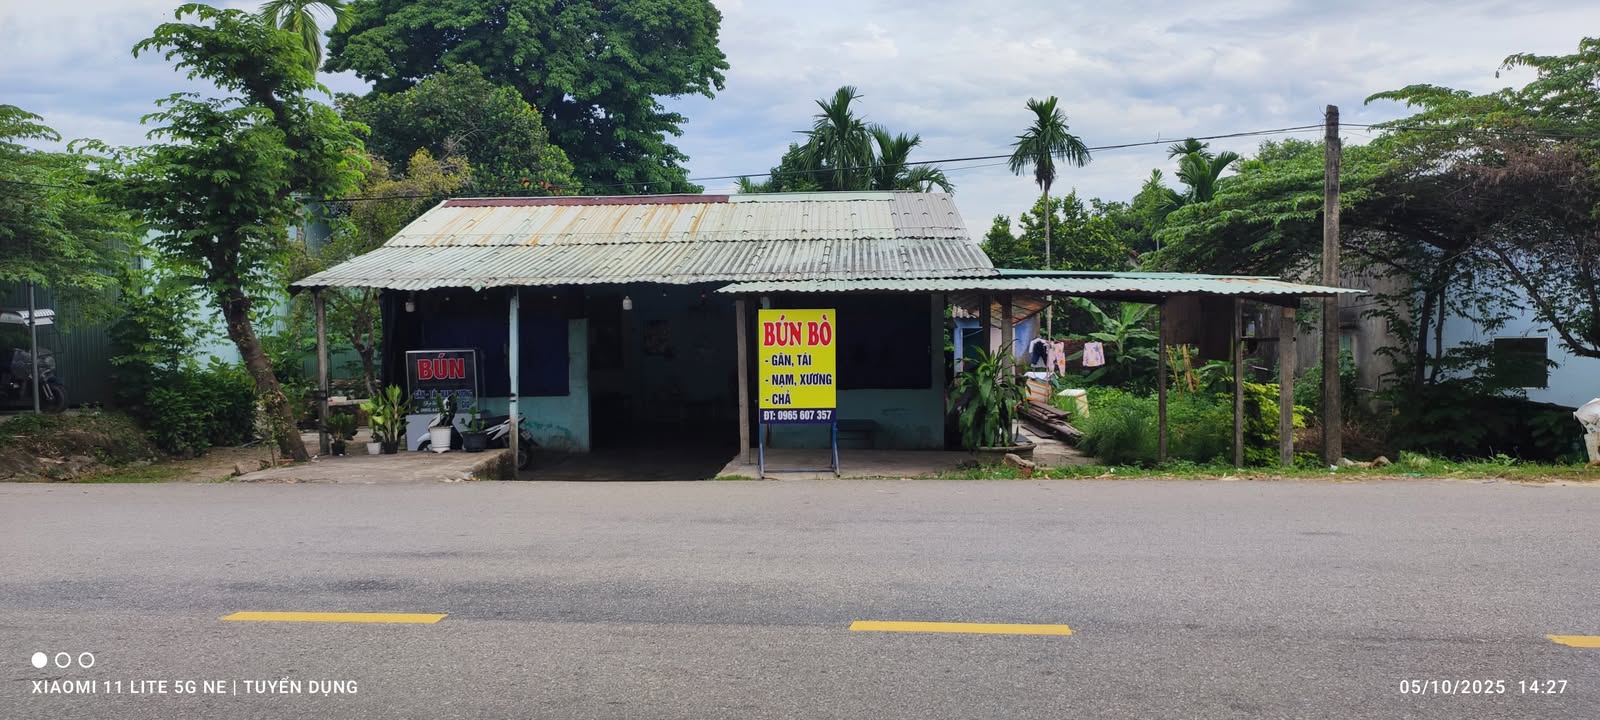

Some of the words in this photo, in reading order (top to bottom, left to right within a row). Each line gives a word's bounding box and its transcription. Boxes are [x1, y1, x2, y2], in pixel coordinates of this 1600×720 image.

[763, 314, 803, 346] BÚN
[807, 314, 832, 346] BÒ
[417, 353, 465, 380] BÚN
[797, 352, 812, 366] TÁI
[772, 374, 797, 388] NẠM,
[800, 373, 832, 385] XƯƠNG
[772, 389, 791, 405] CHẢ
[763, 410, 776, 420] ĐT:
[777, 410, 798, 420] 0965
[799, 410, 815, 420] 607
[816, 410, 832, 420] 357
